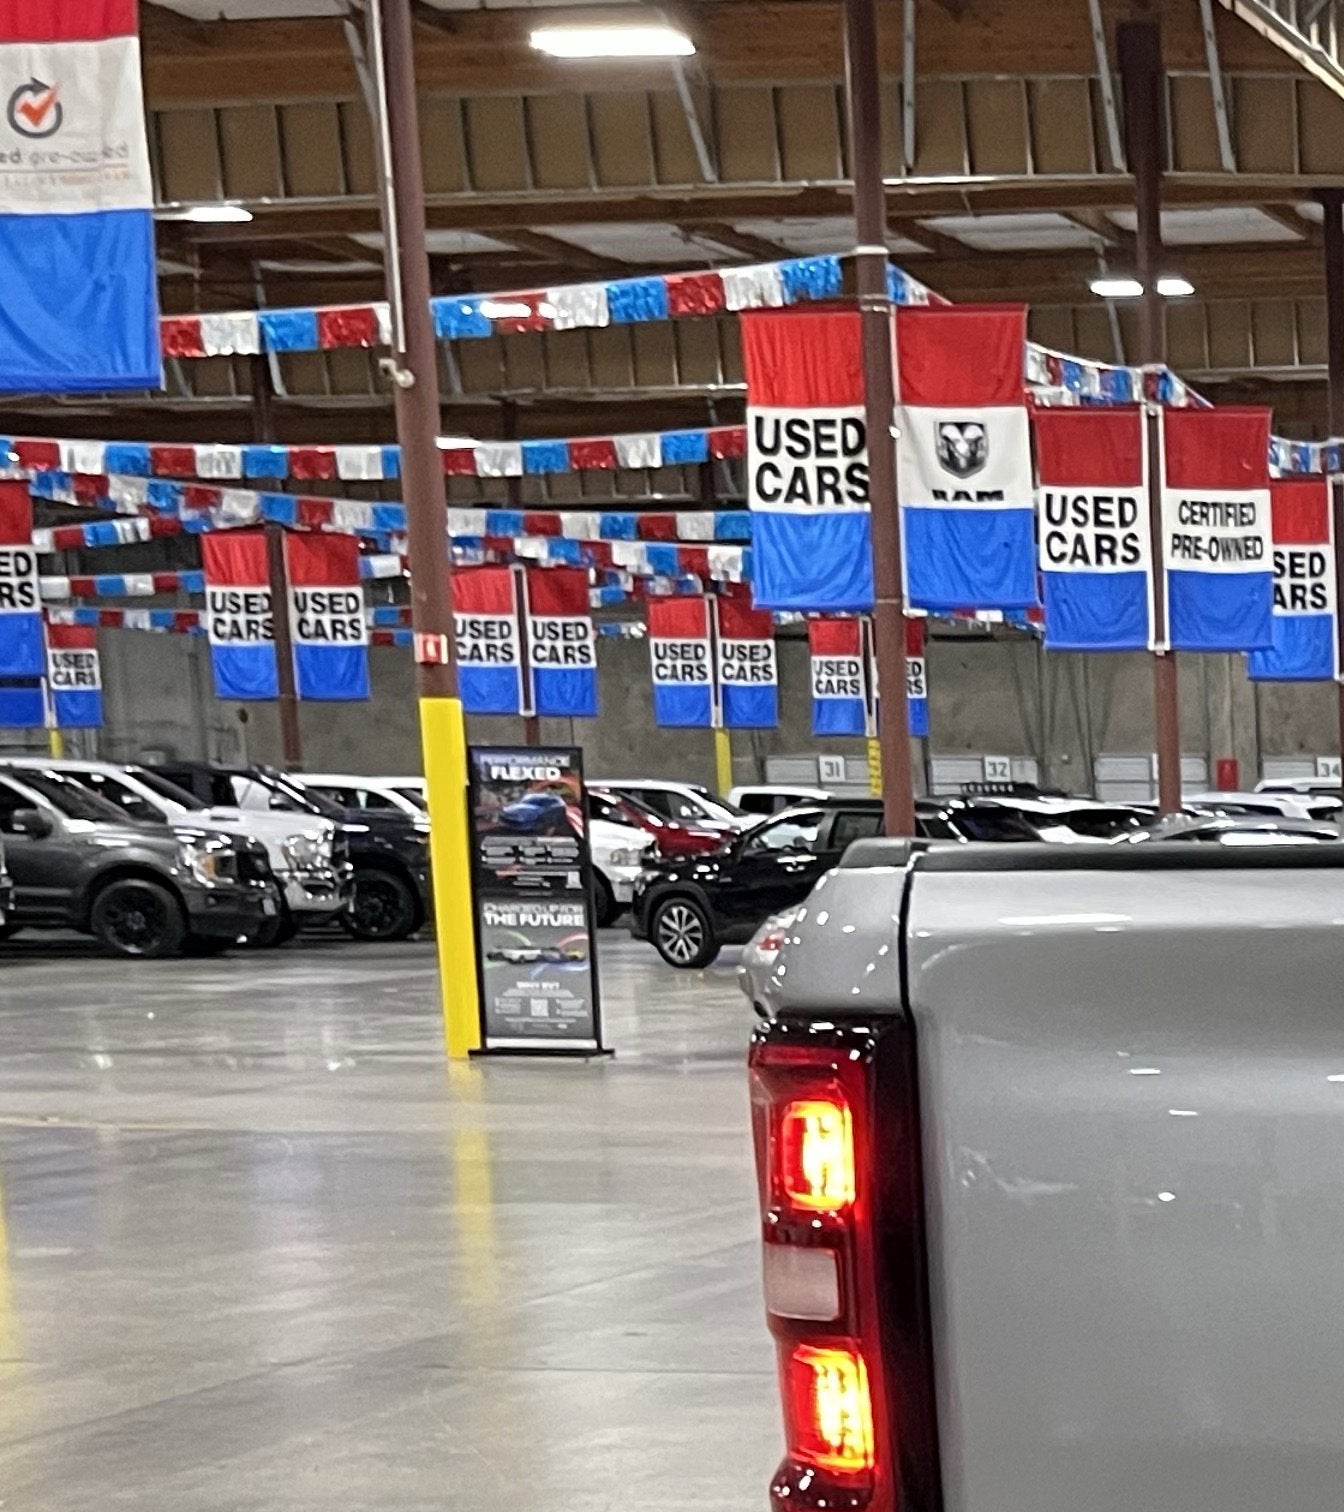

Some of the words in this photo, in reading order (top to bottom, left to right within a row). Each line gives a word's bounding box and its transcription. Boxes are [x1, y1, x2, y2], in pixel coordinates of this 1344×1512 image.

[755, 416, 866, 459] USED
[755, 461, 868, 505] CARS
[1046, 493, 1138, 529] USED
[1178, 500, 1257, 527] CERTIFIED
[1046, 532, 1140, 565] CARS
[1171, 534, 1264, 562] PRE-OWNED
[1272, 551, 1326, 578] SED
[210, 592, 272, 615] USED
[294, 592, 360, 615] USED
[1272, 583, 1327, 610] ARS
[213, 617, 274, 640] CARS
[297, 618, 362, 640] CARS
[455, 619, 512, 640] USED
[532, 620, 588, 641] USED
[52, 654, 95, 669] USED
[456, 641, 514, 662] CARS
[532, 644, 591, 664] CARS
[654, 643, 706, 661] USED
[721, 643, 771, 662] USED
[53, 671, 96, 685] CARS
[655, 663, 708, 681] CARS
[721, 665, 773, 682] CARS
[813, 660, 859, 676] USED
[815, 679, 860, 695] CARS
[491, 766, 561, 781] FLEXED
[824, 761, 840, 777] 31
[988, 761, 1008, 777] 32
[483, 912, 518, 926] THE
[519, 913, 585, 927] FUTURE
